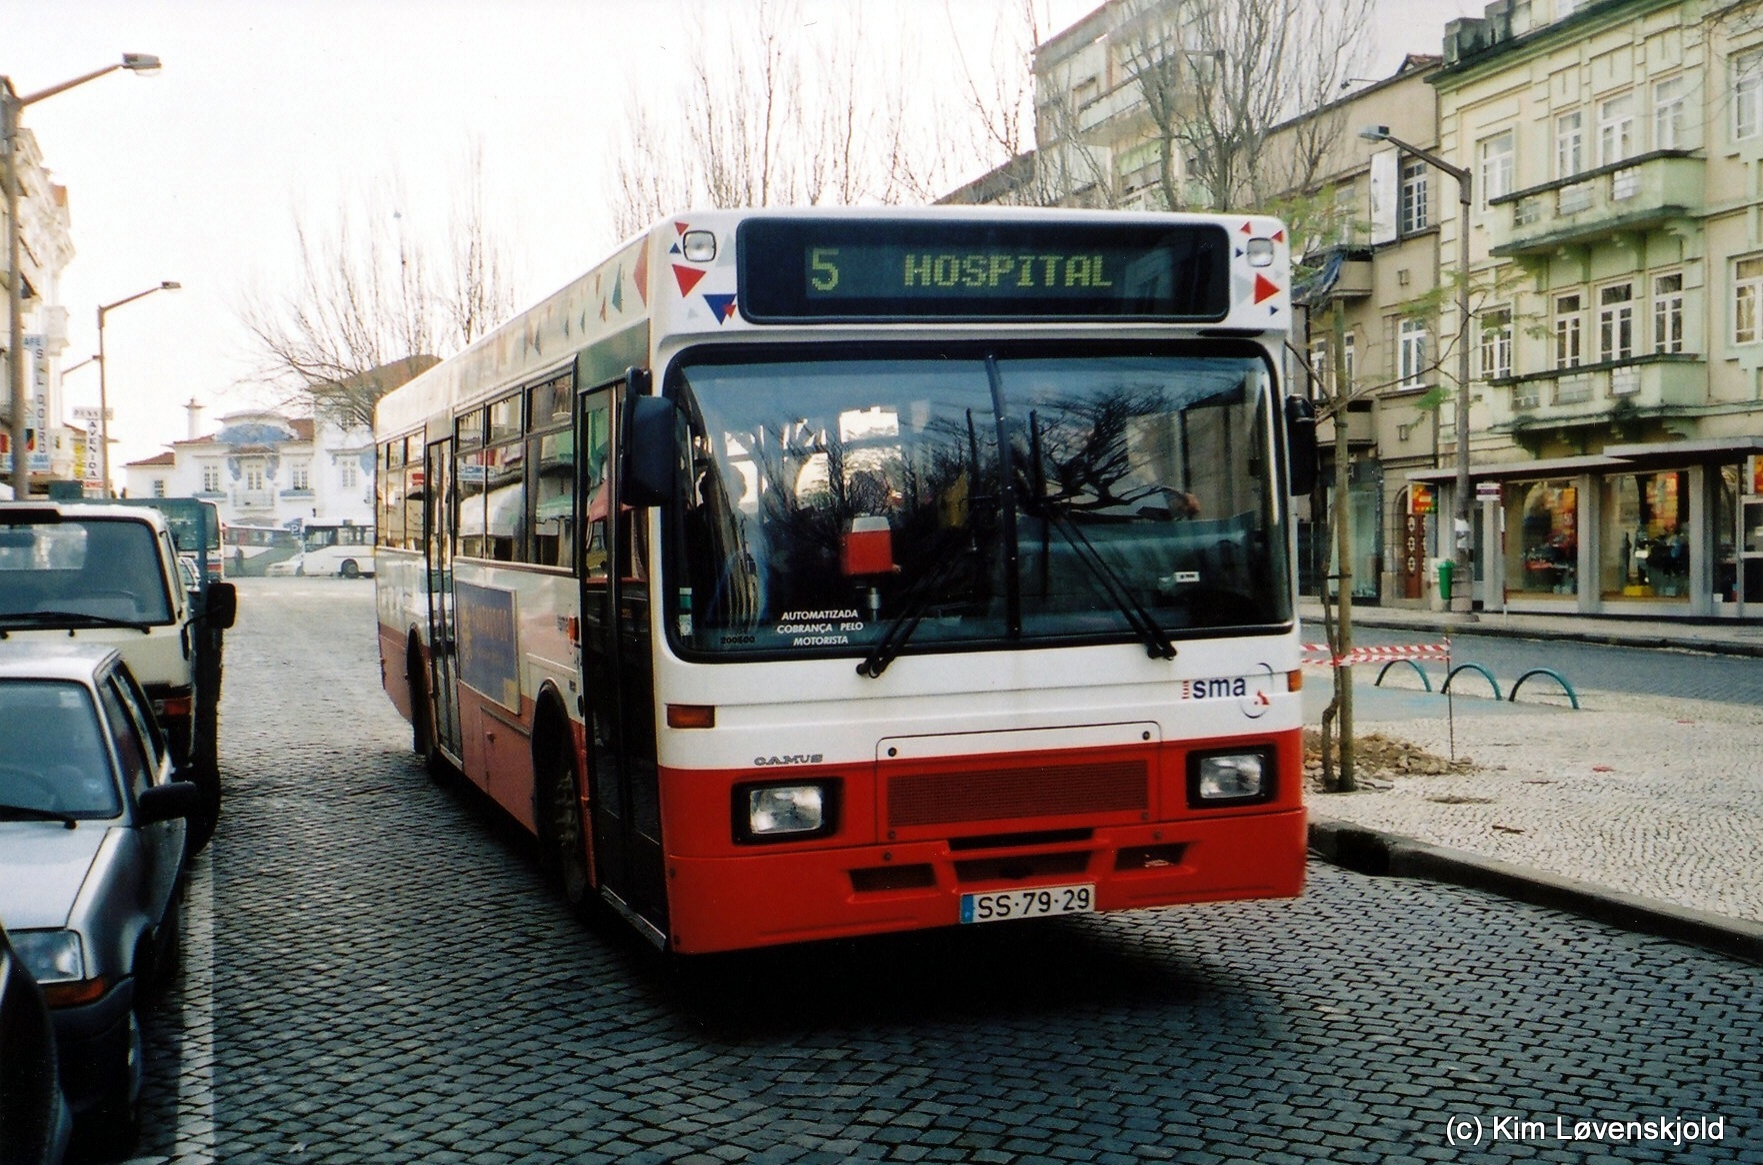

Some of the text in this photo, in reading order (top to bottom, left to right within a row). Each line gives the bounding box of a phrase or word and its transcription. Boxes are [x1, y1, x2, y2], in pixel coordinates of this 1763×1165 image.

[812, 248, 1113, 291] 5 HOSPITAL
[88, 421, 97, 477] AVENIDA
[291, 524, 299, 535] P
[781, 609, 859, 621] AUTOMATIZADA
[776, 622, 864, 635] COBRANÇA PELO
[793, 636, 849, 647] MOTORISTA
[1192, 677, 1246, 699] sma
[753, 753, 823, 767] CAMUS
